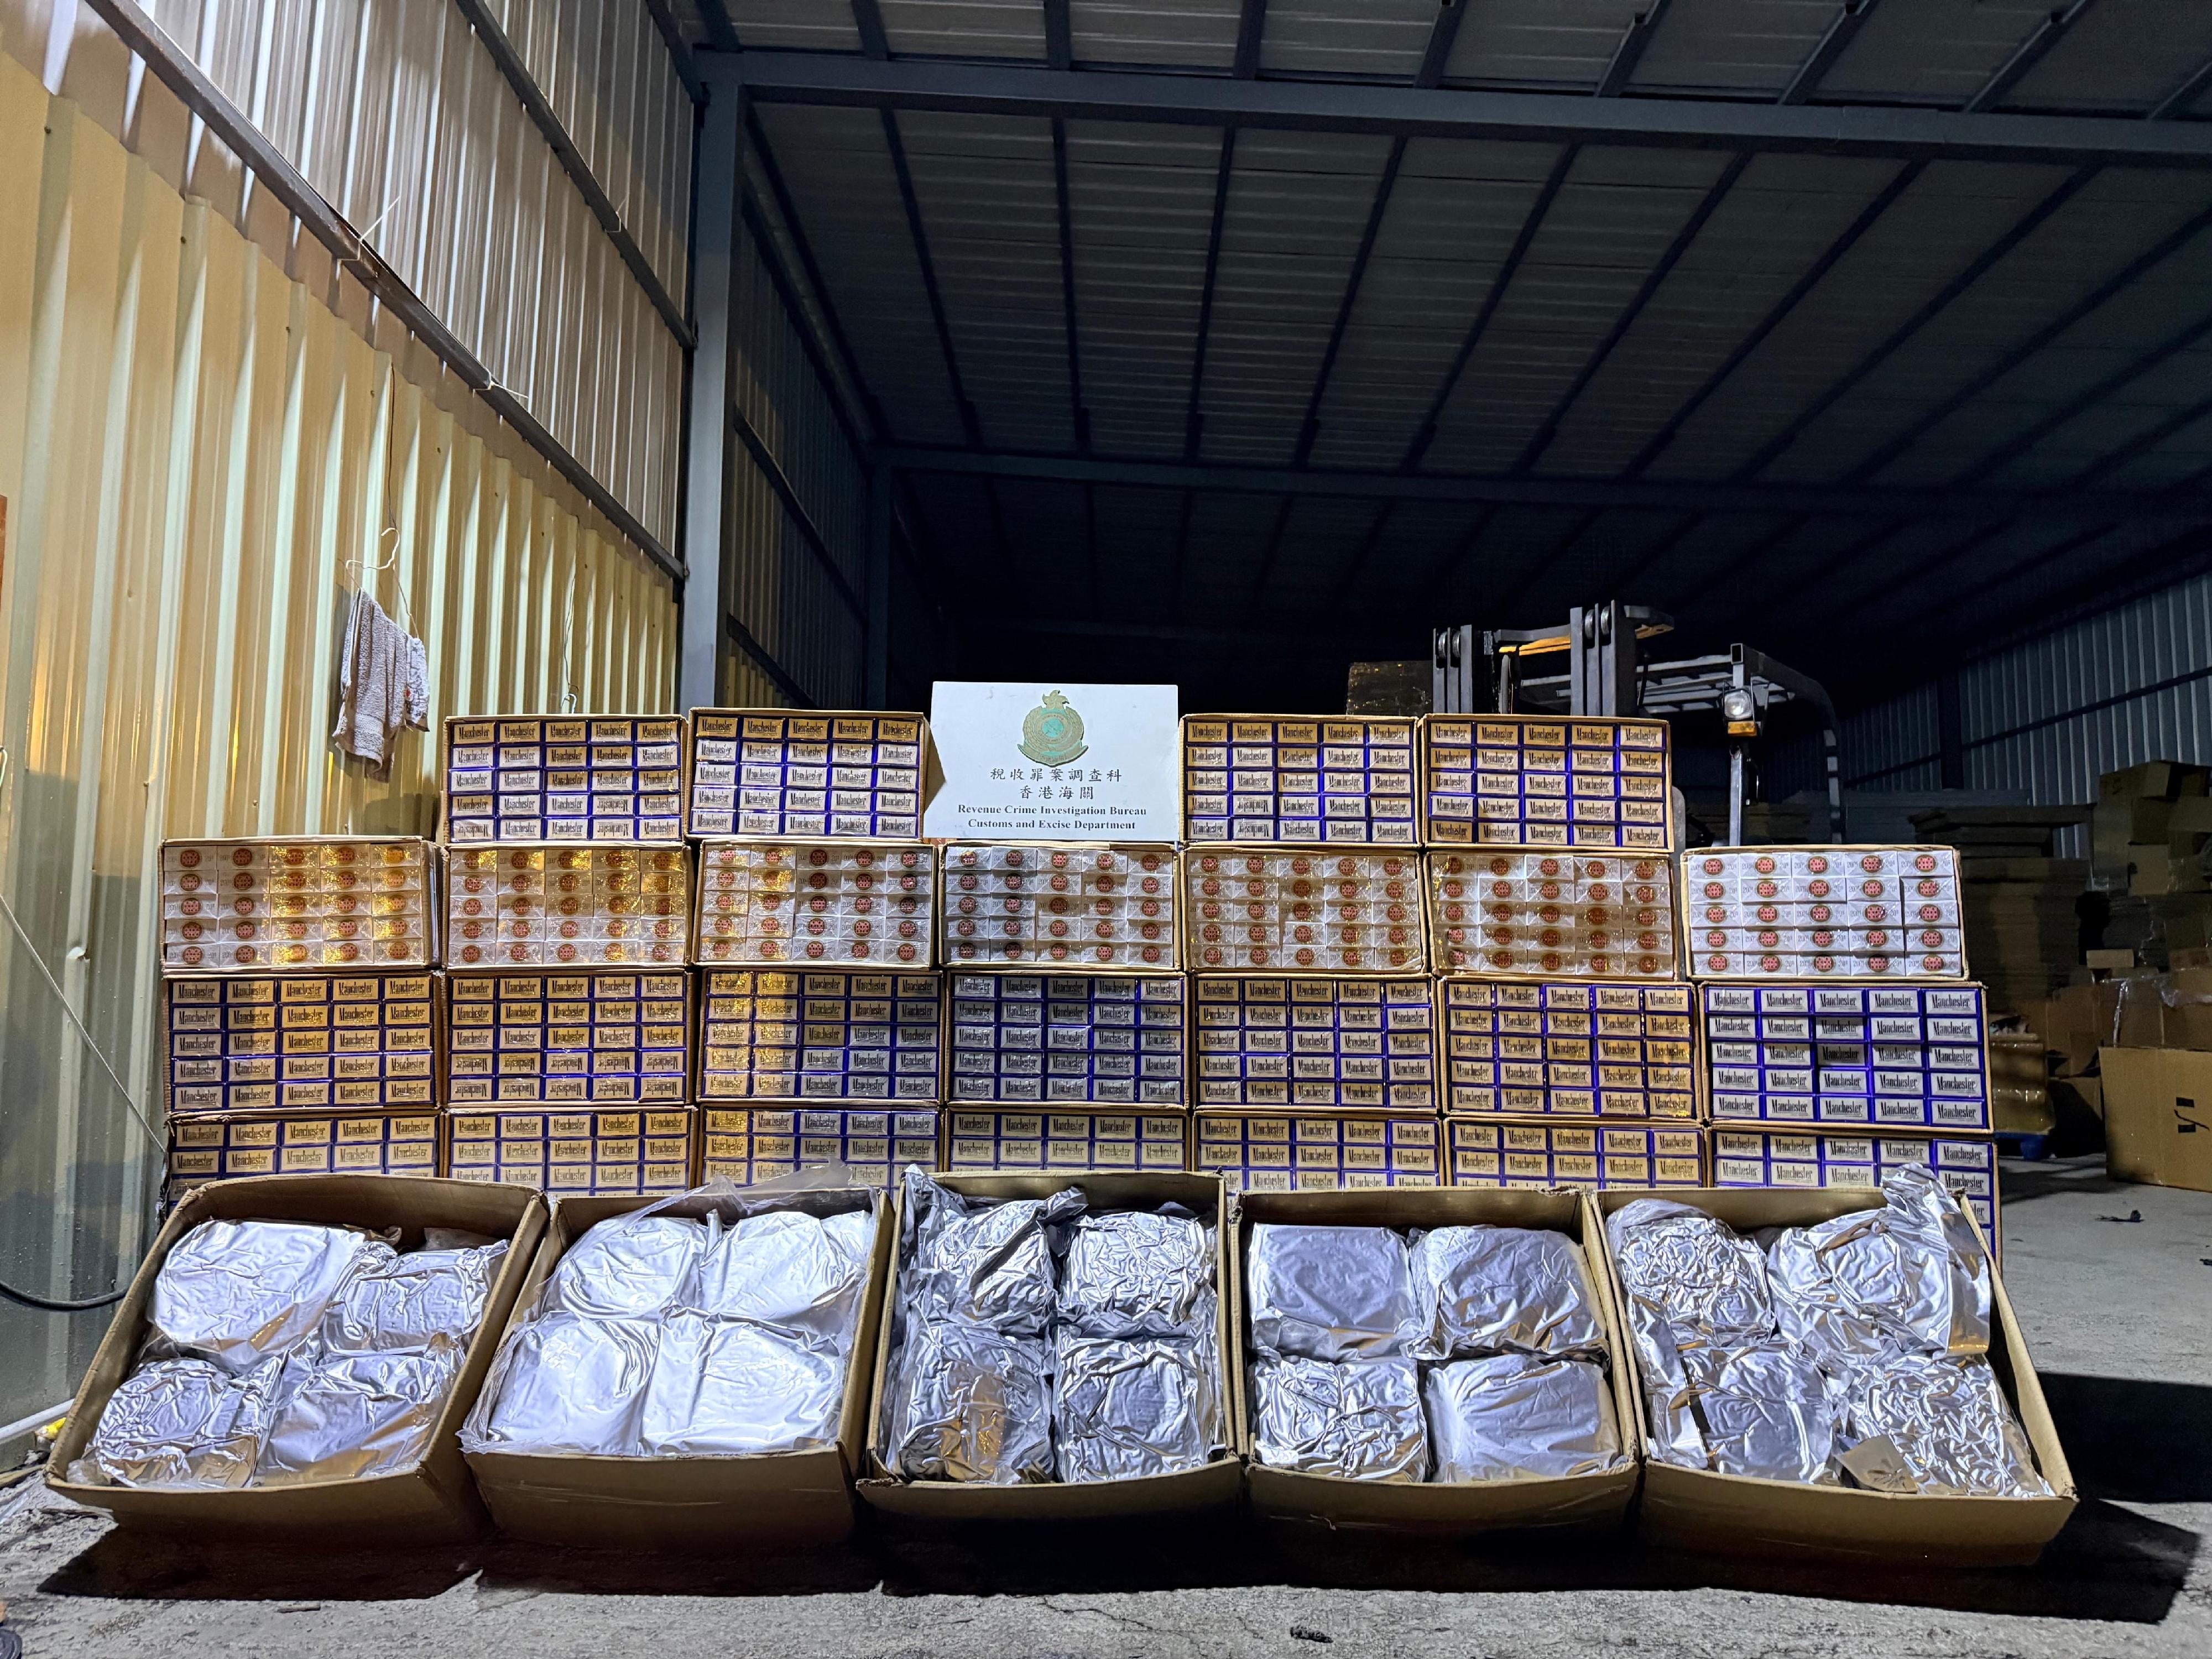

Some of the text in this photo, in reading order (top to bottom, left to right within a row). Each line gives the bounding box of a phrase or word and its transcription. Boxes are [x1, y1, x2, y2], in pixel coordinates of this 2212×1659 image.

[459, 726, 489, 739] Manchester
[505, 725, 535, 739] Manchester
[596, 724, 627, 737] Manchester
[702, 719, 732, 732] Manchester
[748, 721, 778, 734] Manchester
[838, 722, 868, 734] Manchester
[1192, 725, 1222, 739] Manchester
[1238, 725, 1267, 738] Manchester
[1283, 726, 1312, 740] Manchester
[1482, 727, 1513, 740] Manchester
[1529, 727, 1560, 741] Manchester
[458, 749, 488, 763] Manchester
[505, 749, 535, 762] Manchester
[597, 749, 628, 761] Manchester
[1238, 749, 1267, 762] Manchester
[1283, 750, 1312, 763] Manchester
[1374, 752, 1405, 765] Manchester
[1435, 750, 1467, 764] Manchester
[1482, 752, 1513, 764] Manchester
[1577, 753, 1609, 765] Manchester
[1625, 754, 1657, 768] Manchester
[597, 773, 628, 786] Manchester
[1283, 775, 1313, 787] Manchester
[1375, 776, 1405, 788] Manchester
[1482, 776, 1514, 790] Manchester
[1530, 777, 1561, 791] Manchester
[1019, 785, 1093, 799] 香港海關
[505, 797, 535, 810] Manchester
[552, 798, 582, 811] Manchester
[791, 793, 821, 806] Manchester
[1192, 797, 1222, 811] Manchester
[1284, 799, 1314, 813] Manchester
[1330, 799, 1360, 813] Manchester
[958, 805, 1146, 816] Revenue Crime Investigation Bureau
[1483, 801, 1514, 815] Manchester
[1530, 801, 1562, 815] Manchester
[968, 819, 1013, 827] Customs
[1039, 820, 1071, 828] Excise
[1074, 821, 1136, 831] Department
[1285, 823, 1315, 835] Manchester
[1484, 825, 1515, 839] Manchester
[178, 984, 215, 999] Manchester
[232, 984, 268, 998] Manchester
[287, 983, 321, 997] Manchester
[458, 982, 489, 995] Manchester
[505, 980, 536, 994] Manchester
[1875, 993, 1912, 1007] Manchester
[1932, 994, 1970, 1008] Manchester
[179, 1010, 215, 1025] Manchester
[391, 1006, 425, 1019] Manchester
[457, 1006, 489, 1020] Manchester
[505, 1005, 537, 1019] Manchester
[1006, 1006, 1037, 1020] Manchester
[1204, 1008, 1235, 1021] Manchester
[1250, 1008, 1281, 1022] Manchester
[1344, 1009, 1376, 1022] Manchester
[1715, 1019, 1750, 1032] Manchester
[1767, 1019, 1803, 1033] Manchester
[1877, 1020, 1914, 1034] Manchester
[1933, 1021, 1971, 1035] Manchester
[457, 1032, 489, 1046] Manchester
[505, 1030, 536, 1044] Manchester
[809, 1027, 839, 1040] Manchester
[1006, 1030, 1037, 1044] Manchester
[1298, 1034, 1329, 1047] Manchester
[179, 1036, 216, 1051] Manchester
[1456, 1038, 1488, 1052] Manchester
[1717, 1044, 1751, 1058] Manchester
[1769, 1046, 1804, 1060] Manchester
[1934, 1050, 1973, 1063] Manchester
[807, 1052, 838, 1066] Manchester
[1204, 1058, 1235, 1072] Manchester
[1251, 1059, 1283, 1072] Manchester
[1298, 1060, 1330, 1073] Manchester
[1346, 1061, 1378, 1074] Manchester
[1457, 1063, 1489, 1077] Manchester
[1553, 1067, 1587, 1081] Manchester
[1719, 1071, 1753, 1084] Manchester
[1771, 1073, 1806, 1087] Manchester
[1824, 1073, 1860, 1087] Manchester
[1880, 1074, 1917, 1088] Manchester
[1005, 1081, 1036, 1094] Manchester
[1937, 1076, 1975, 1090] Manchester
[1772, 1099, 1807, 1113] Manchester
[1825, 1100, 1861, 1114] Manchester
[1881, 1102, 1918, 1115] Manchester
[1938, 1104, 1976, 1118] Manchester
[459, 1119, 491, 1133] Manchester
[603, 1117, 634, 1131] Manchester
[651, 1116, 682, 1130] Manchester
[758, 1115, 789, 1128] Manchester
[1006, 1118, 1037, 1132] Manchester
[1053, 1118, 1084, 1132] Manchester
[1100, 1119, 1131, 1133] Manchester
[1206, 1121, 1237, 1135] Manchester
[1253, 1122, 1285, 1136] Manchester
[1349, 1124, 1380, 1138] Manchester
[1397, 1125, 1430, 1139] Manchester
[1460, 1128, 1493, 1142] Manchester
[1509, 1130, 1541, 1144] Manchester
[1557, 1131, 1590, 1145] Manchester
[1722, 1136, 1757, 1150] Manchester
[1775, 1139, 1811, 1152] Manchester
[1830, 1141, 1866, 1155] Manchester
[1253, 1147, 1285, 1161] Manchester
[1349, 1149, 1380, 1162] Manchester
[1944, 1146, 1982, 1160] Manchester
[178, 1155, 213, 1168] Manchester
[1510, 1156, 1542, 1170] Manchester
[1559, 1158, 1592, 1171] Manchester
